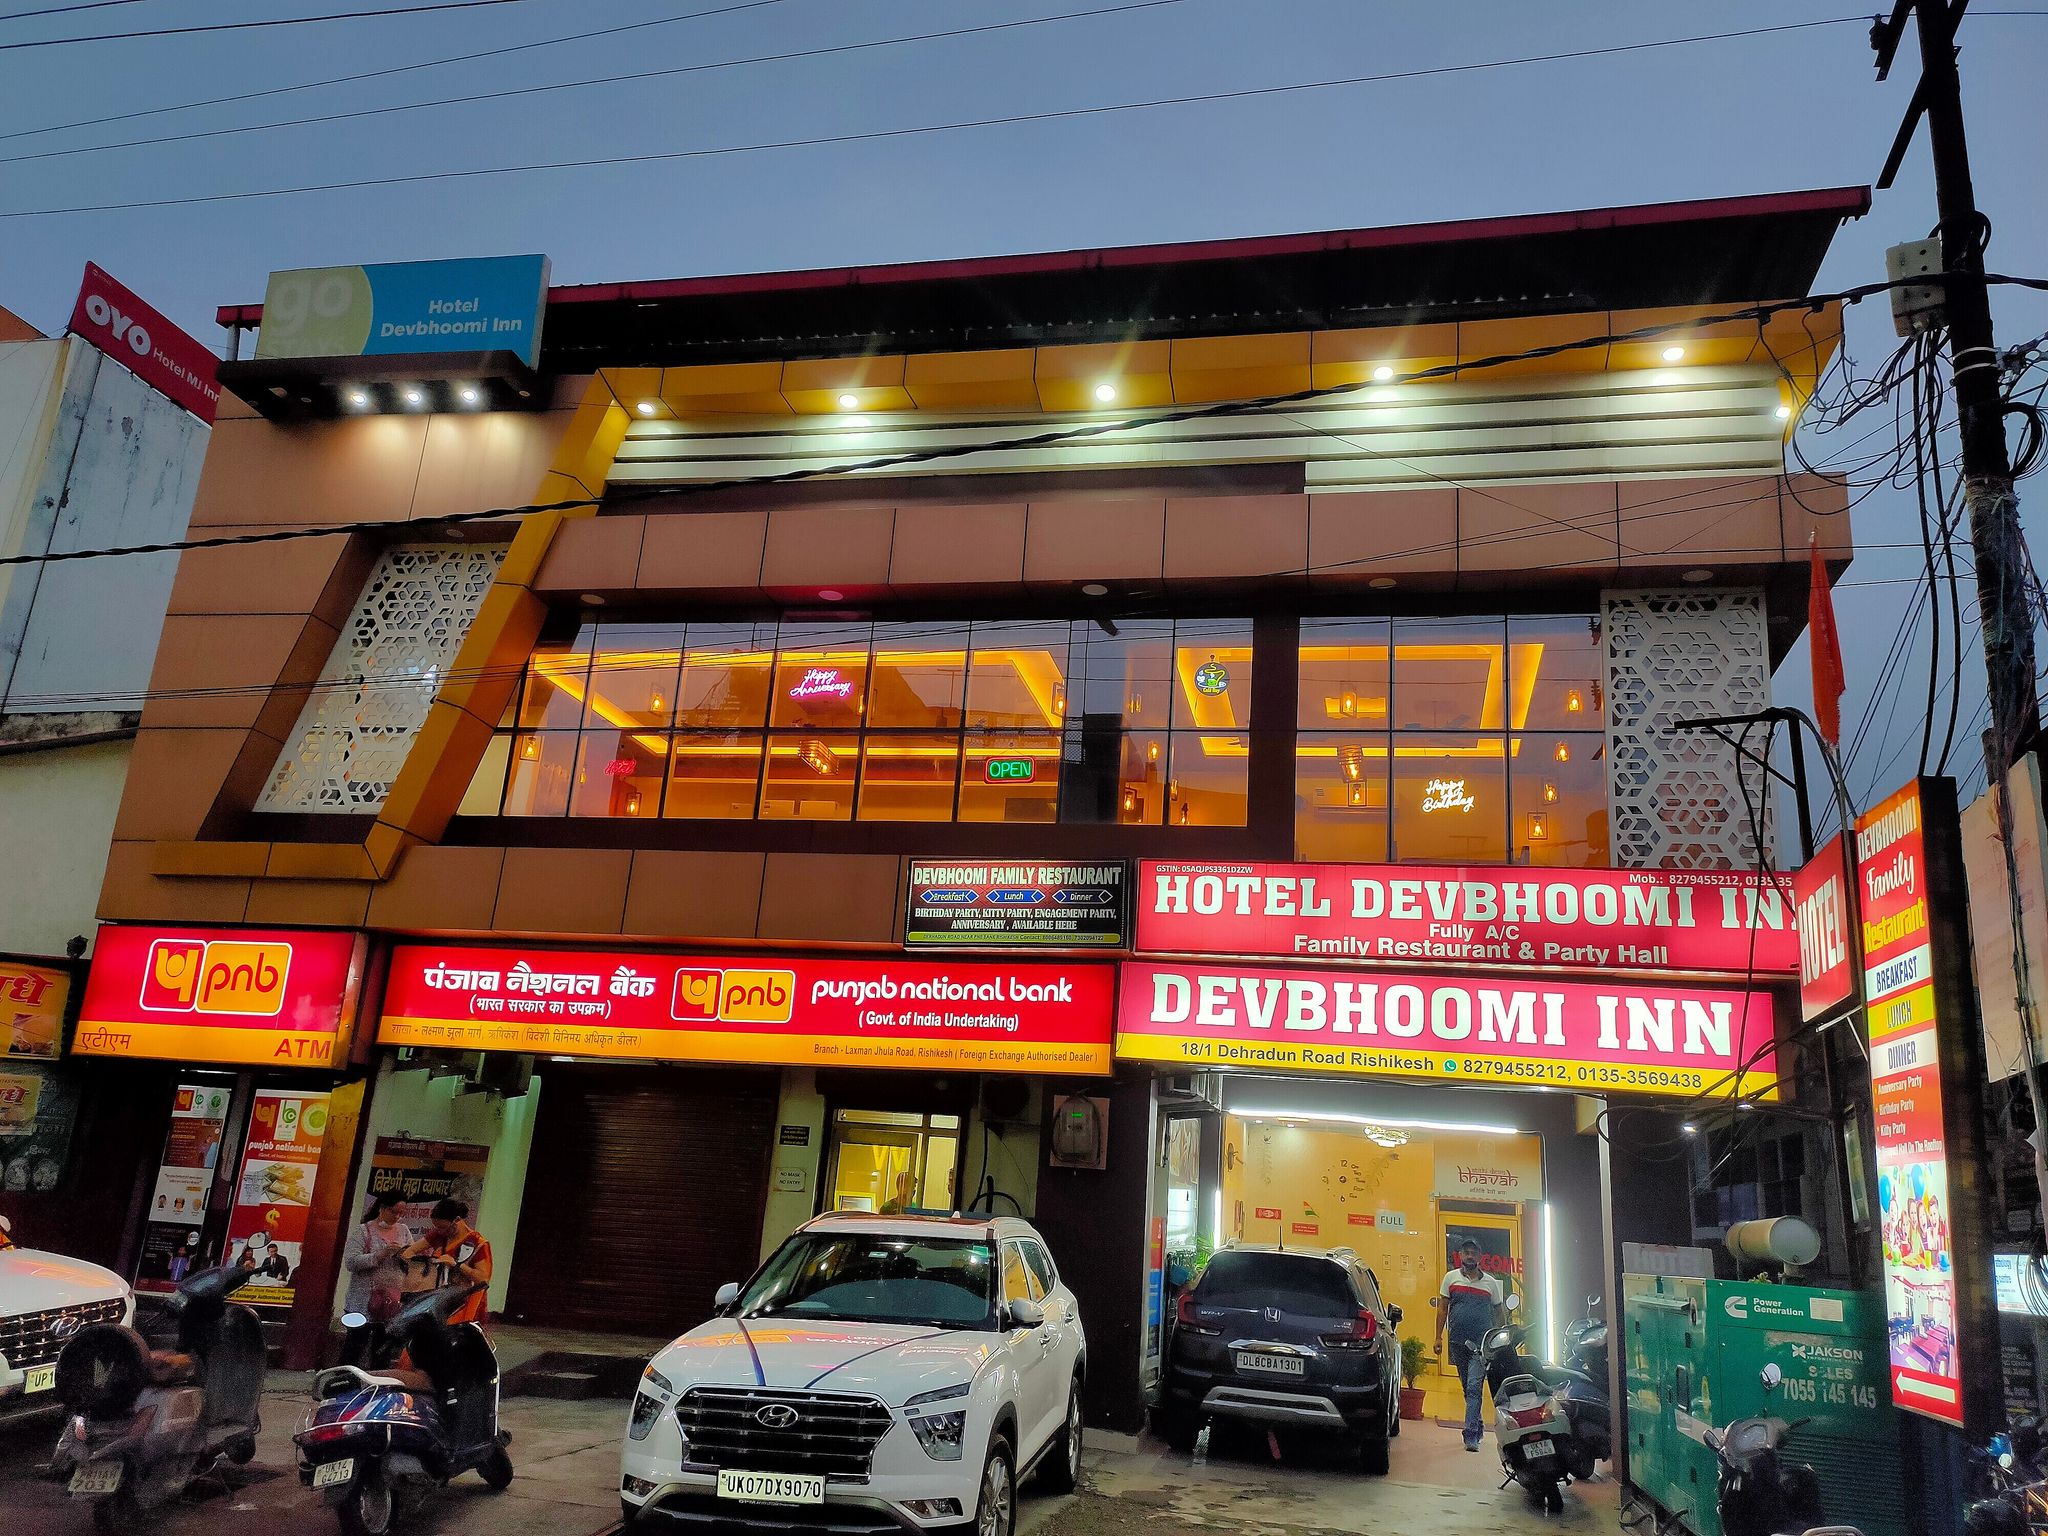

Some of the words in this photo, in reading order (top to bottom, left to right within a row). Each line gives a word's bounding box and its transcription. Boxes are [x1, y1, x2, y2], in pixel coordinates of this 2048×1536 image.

[270, 277, 353, 336] go
[429, 297, 479, 315] Hotel
[85, 294, 151, 356] OYO
[380, 316, 488, 338] Devbhoomi
[493, 318, 522, 333] Inn
[153, 347, 186, 379] Hotel
[186, 371, 202, 392] MJ
[804, 668, 838, 684] Happy
[790, 679, 851, 698] Anniversary
[989, 762, 1032, 778] OPEN
[1425, 778, 1466, 798] Happy
[1422, 793, 1475, 813] Birthday
[1857, 796, 1917, 864] DEVBHOOMI
[914, 867, 987, 885] DEVBHOOMI
[990, 867, 1036, 885] FAMILY
[1038, 867, 1122, 885] RESTAURANT
[1156, 865, 1181, 873] GSTIN:
[1866, 855, 1915, 902] Family
[1629, 873, 1664, 884] Mob.:
[1669, 874, 1743, 887] 8279455212,
[932, 892, 966, 901] Breakfast
[1004, 892, 1024, 900] Lunch
[1070, 892, 1094, 901] Dinner
[1154, 875, 1332, 917] HOTEL
[1351, 879, 1696, 928] DEVBHOOMI
[1721, 887, 1798, 930] IN
[914, 907, 955, 918] BIRTHDAY
[955, 908, 982, 919] PARTY,
[982, 908, 1005, 918] KITTY
[1005, 908, 1033, 919] PARTY,
[1034, 908, 1089, 919] ENGAGEMENT
[1012, 920, 1053, 930] AVAILABLE
[1055, 921, 1077, 930] HERE
[1430, 923, 1474, 940] Fully
[1484, 925, 1520, 940] A/C
[1798, 874, 1845, 987] HOTEL
[1864, 897, 1925, 955] Restaurant
[1294, 934, 1370, 956] Family
[1378, 937, 1511, 959] Restaurant
[1518, 943, 1536, 960] &
[1544, 943, 1610, 965] Party
[1618, 945, 1668, 964] Hall
[204, 951, 280, 1004] pnb
[423, 961, 500, 992] पंजाब
[507, 961, 601, 997] नैशनल
[610, 965, 657, 998] बैंक
[1876, 956, 1918, 993] BREAKFAST
[726, 977, 787, 1014] pnb
[811, 975, 897, 1006] punjab
[900, 977, 1002, 1002] national
[1009, 977, 1073, 1003] bank
[469, 994, 504, 1014] (भारत
[508, 999, 546, 1015] सरकार
[549, 1000, 564, 1014] का
[568, 999, 612, 1019] उपक्रम)
[1150, 973, 1567, 1046] DEVBHOOMI
[1597, 995, 1733, 1057] INN
[1886, 1000, 1912, 1030] LUNCH
[898, 1011, 912, 1026] of
[913, 1012, 941, 1028] India
[944, 1012, 1019, 1032] Undertaking)
[80, 1029, 132, 1053] एटीएम
[421, 1025, 445, 1038] लक्ष्मण
[447, 1025, 465, 1040] झूला
[274, 1037, 332, 1060] ATM
[814, 1043, 839, 1055] Branch
[845, 1044, 873, 1057] Laxman
[874, 1045, 893, 1058] Jhula
[918, 1046, 954, 1060] Rishikesh
[989, 1048, 1025, 1063] Exchange
[1026, 1050, 1068, 1062] Authorised
[1888, 1041, 1916, 1069] DINNER
[1180, 1042, 1212, 1057] 18/1
[1217, 1045, 1298, 1063] Dehradun
[1302, 1048, 1345, 1066] Road
[1350, 1052, 1435, 1072] Rishikesh
[1463, 1059, 1572, 1083] 8279455212,
[1577, 1065, 1702, 1089] 0135-3569438
[1907, 1075, 1922, 1089] Party
[1900, 1099, 1914, 1112] Party
[1892, 1122, 1906, 1135] Party
[248, 1140, 274, 1151] punjab
[275, 1141, 306, 1153] national
[1380, 1215, 1404, 1226] FULL
[1753, 1298, 1782, 1307] Power
[1753, 1305, 1804, 1317] Generation
[1243, 1354, 1302, 1371] DL8CBA1301
[1806, 1346, 1863, 1361] JAKSON
[1781, 1377, 1816, 1401] 7055
[1850, 1385, 1877, 1409] 145
[728, 1476, 821, 1498] UK07DX9070
